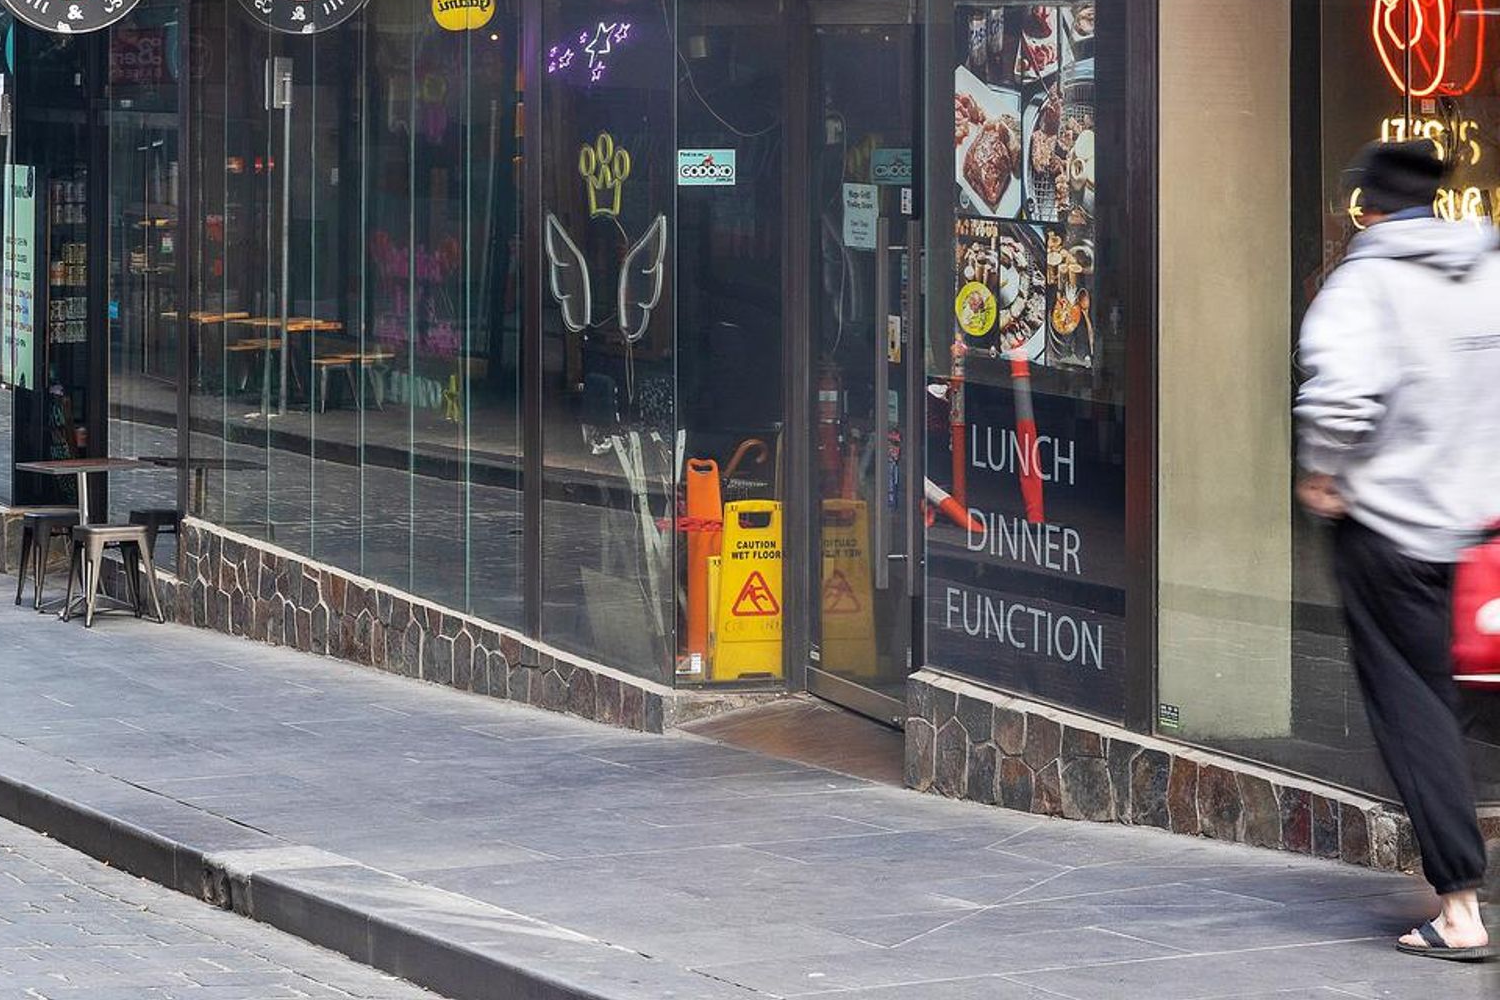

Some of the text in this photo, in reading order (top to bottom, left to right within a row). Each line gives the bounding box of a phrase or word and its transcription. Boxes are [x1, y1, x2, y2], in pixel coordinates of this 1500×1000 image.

[67, 4, 84, 20] &
[972, 424, 1075, 485] LUNCH
[732, 551, 781, 559] WET FLOOR
[737, 541, 776, 549] CAUTION
[967, 508, 1081, 575] DINNER
[947, 587, 1103, 670] FUNCTION
